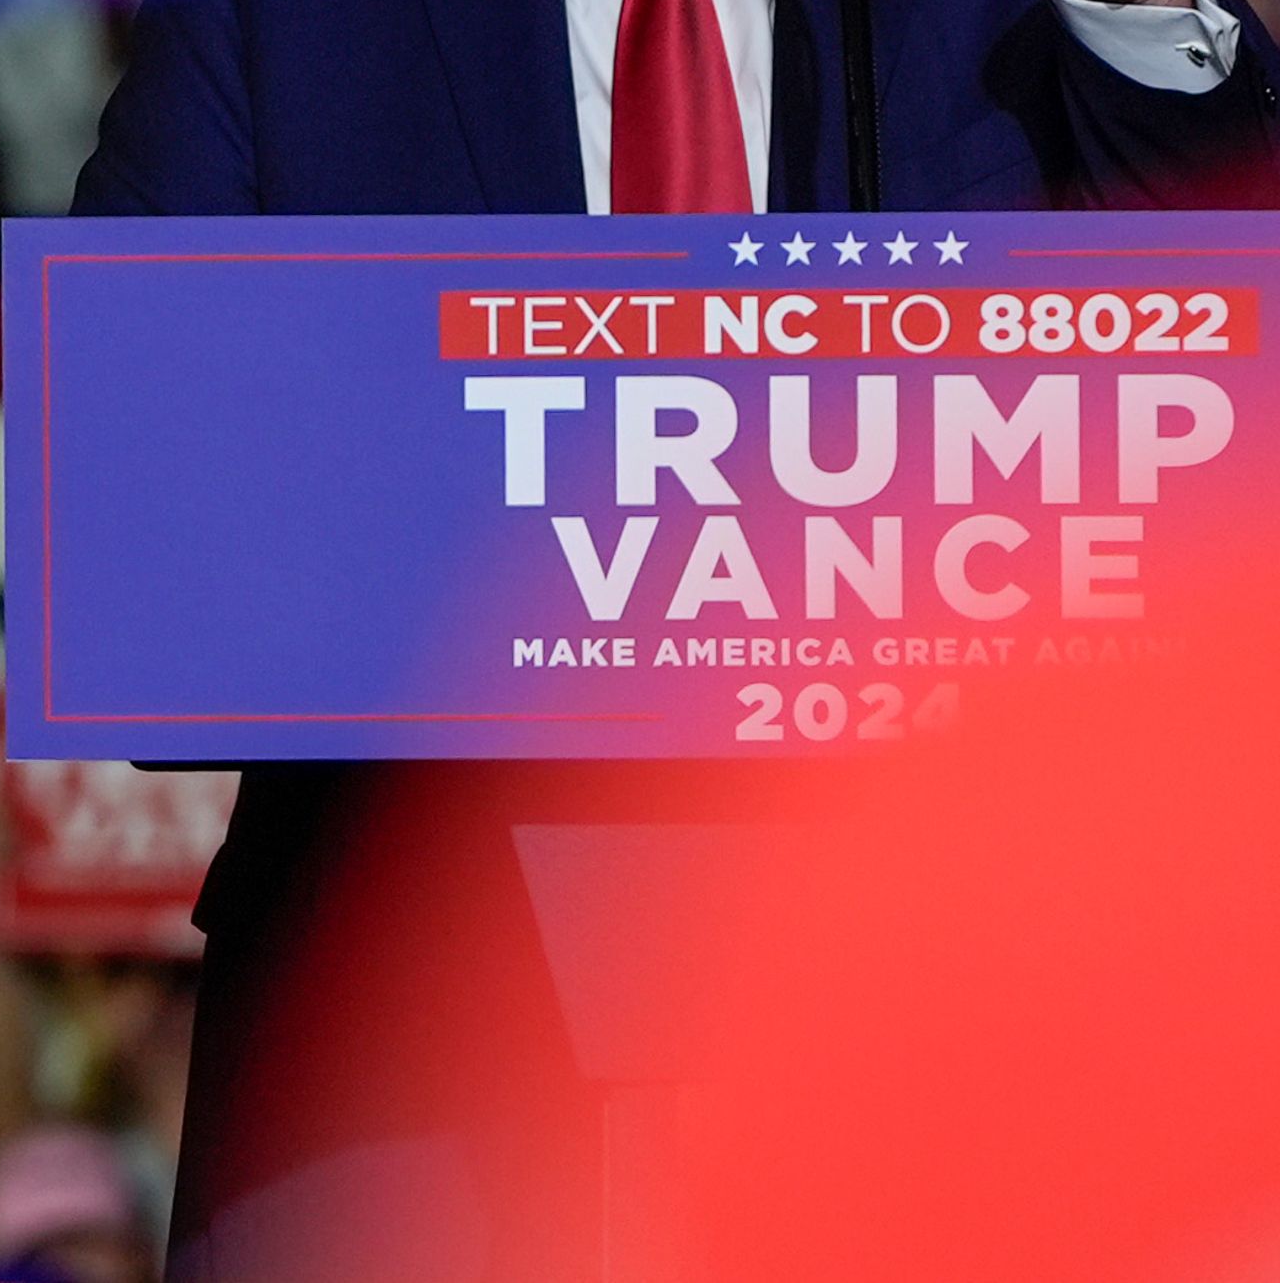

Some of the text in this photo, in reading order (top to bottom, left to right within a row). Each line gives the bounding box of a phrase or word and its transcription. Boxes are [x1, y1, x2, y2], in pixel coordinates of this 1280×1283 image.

[469, 292, 1230, 355] TEXT NC TO 88022
[463, 373, 1236, 507] TRUMP
[550, 514, 1146, 621] VANCE
[512, 637, 637, 668] MAKE
[652, 637, 855, 668] AMERICA
[872, 636, 1017, 667] GREAT
[734, 682, 962, 742] 2024
